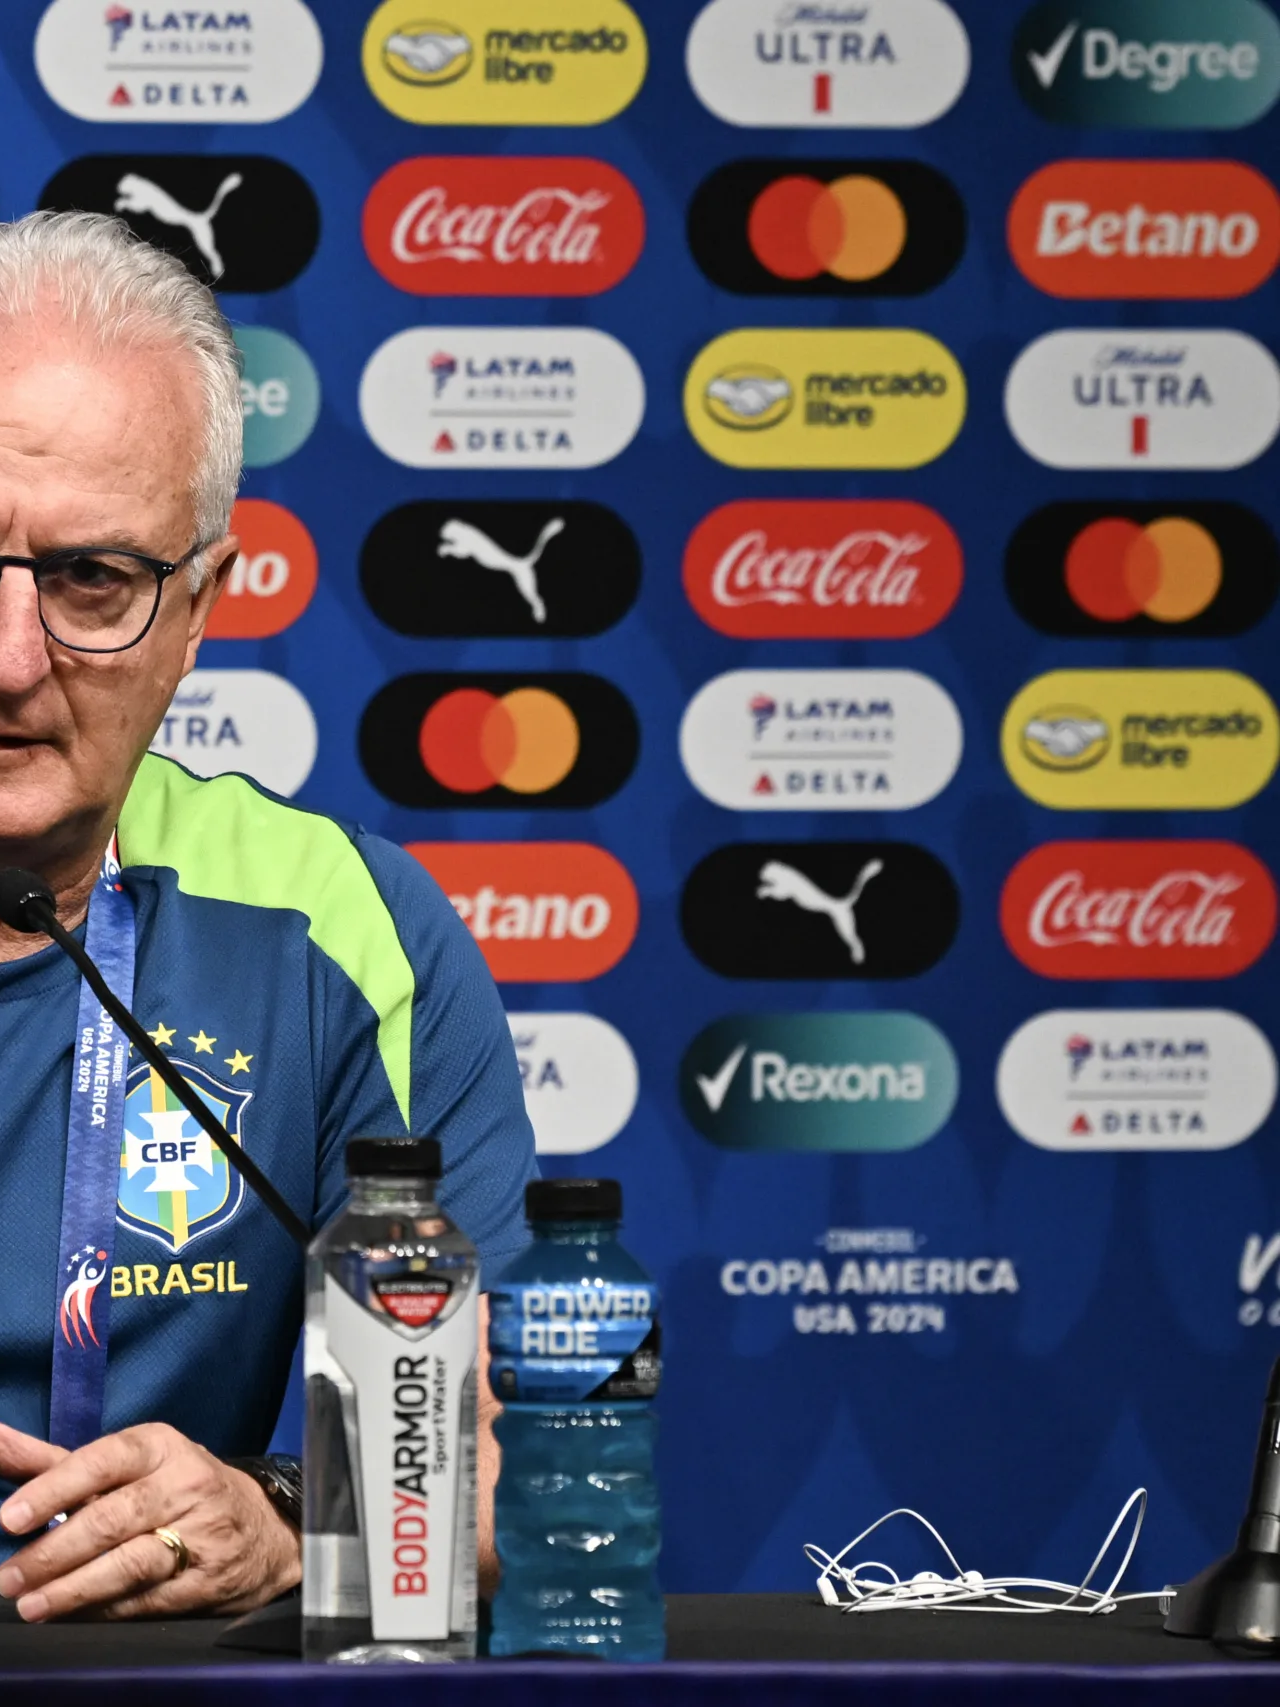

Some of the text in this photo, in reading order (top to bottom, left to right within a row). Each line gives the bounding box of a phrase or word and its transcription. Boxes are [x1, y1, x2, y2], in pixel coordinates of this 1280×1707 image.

[142, 13, 251, 31] LATAM
[142, 40, 252, 54] AIRLINES
[486, 28, 627, 53] mercado
[756, 32, 895, 64] ULTRA
[486, 57, 553, 83] libre
[1083, 29, 1256, 92] Degree
[144, 84, 248, 105] DELTA
[1037, 202, 1258, 256] Betano
[466, 358, 574, 377] LATAM
[806, 371, 946, 395] mercado
[1074, 374, 1212, 406] ULTRA
[807, 401, 873, 426] libre
[467, 430, 571, 451] DELTA
[786, 701, 893, 719] LATAM
[1123, 712, 1261, 736] mercado
[1123, 742, 1189, 767] libre
[787, 771, 889, 793] DELTA
[98, 1006, 114, 1044] OPA
[77, 1027, 94, 1092] USA 2024
[1102, 1041, 1208, 1059] LATAM
[752, 1052, 922, 1101] Rexona
[1103, 1111, 1204, 1133] DELTA
[141, 1141, 197, 1163] CBF
[110, 1260, 249, 1297] BRASIL
[720, 1258, 1019, 1295] COPA AMERICA
[793, 1304, 945, 1334] USA 2024
[522, 1323, 599, 1355] ADE
[394, 1355, 427, 1597] BODYARMOR
